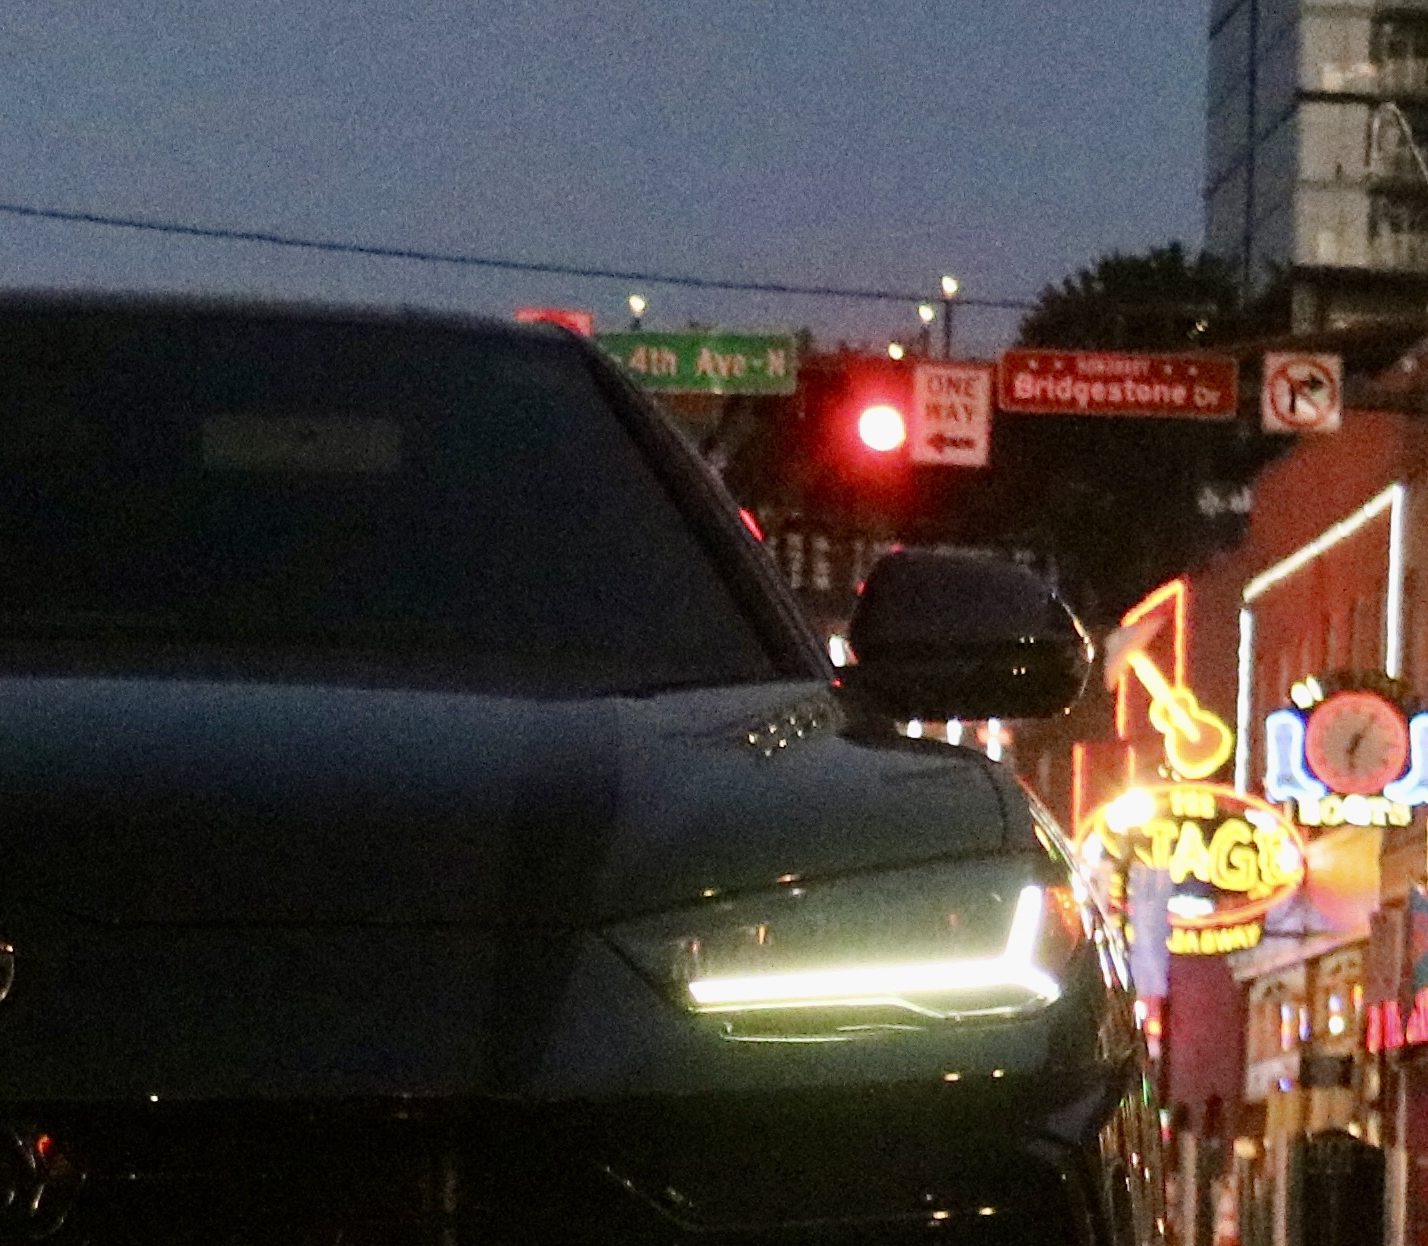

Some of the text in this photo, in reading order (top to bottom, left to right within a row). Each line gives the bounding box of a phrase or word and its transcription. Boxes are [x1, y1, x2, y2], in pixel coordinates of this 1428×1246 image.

[628, 345, 678, 377] 4th
[926, 372, 977, 398] ONE
[1013, 371, 1188, 409] Bridgestone
[924, 401, 975, 423] WAY
